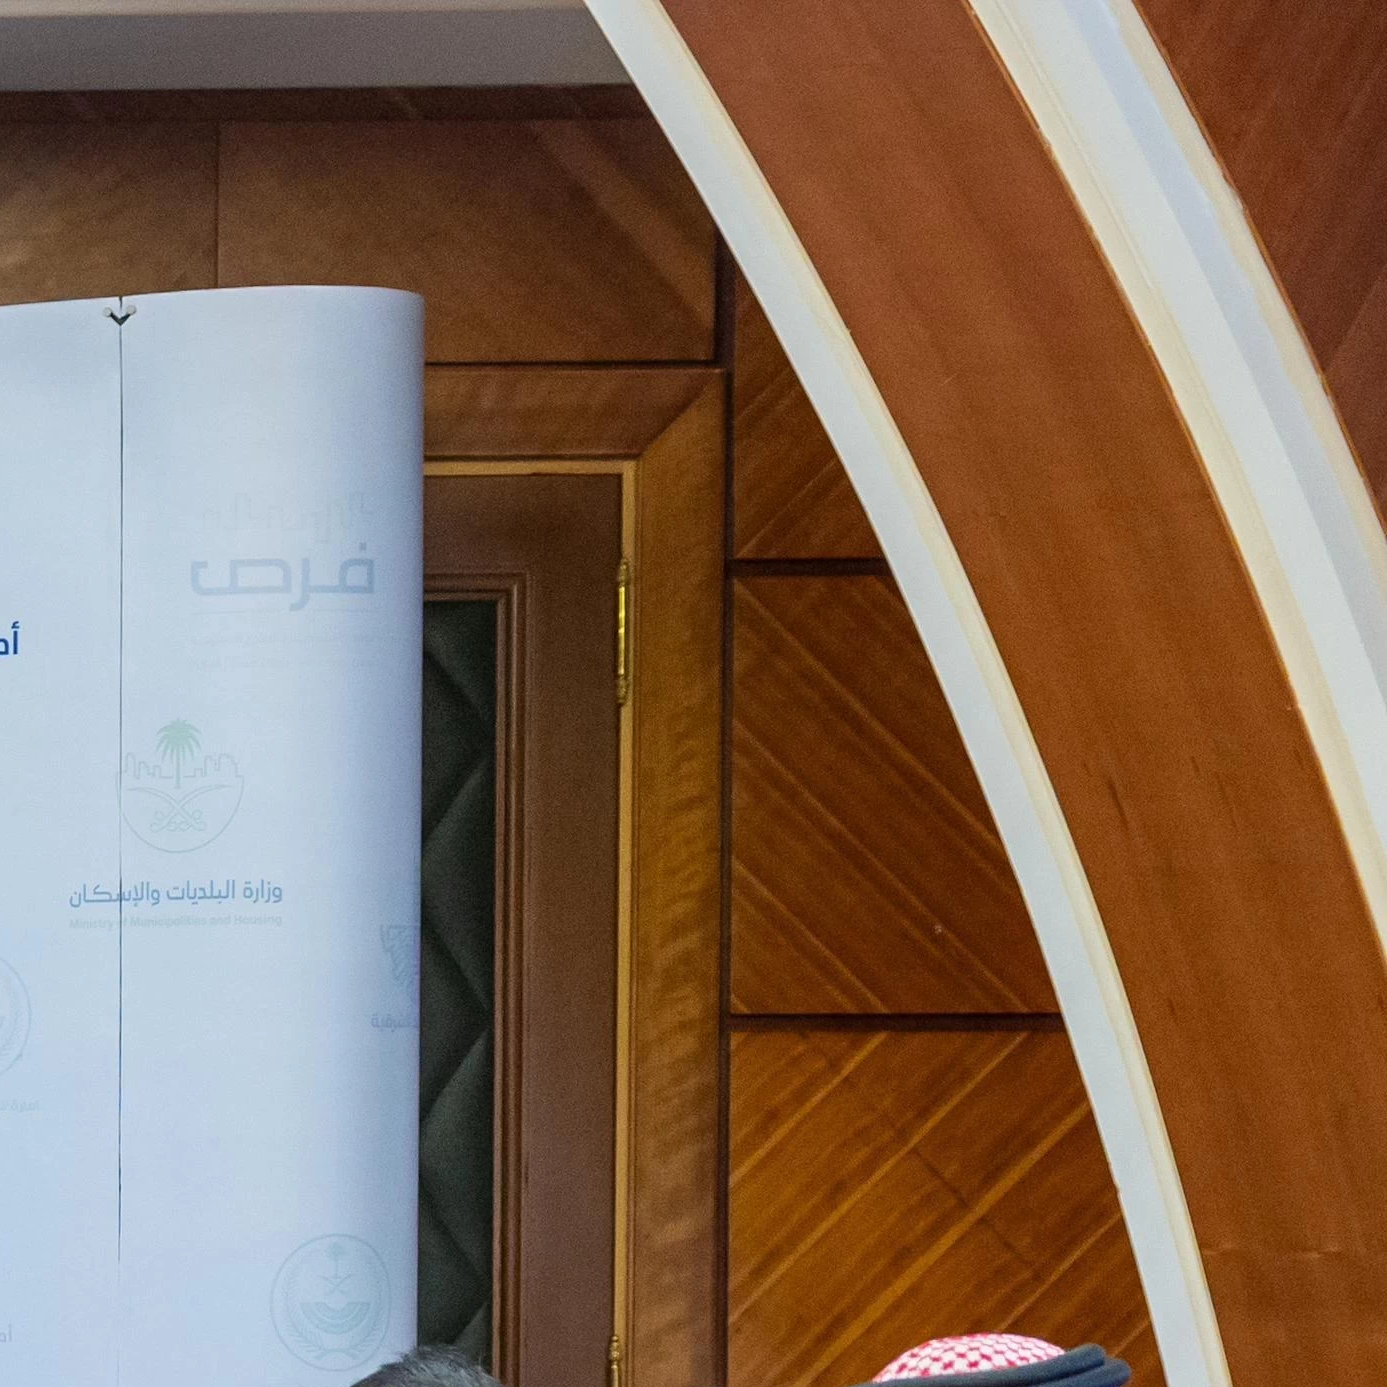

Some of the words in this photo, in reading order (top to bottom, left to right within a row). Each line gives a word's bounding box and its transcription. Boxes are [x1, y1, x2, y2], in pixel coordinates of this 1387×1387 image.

[190, 542, 374, 611] فرص
[166, 879, 235, 905] البلديات
[242, 879, 284, 904] وزارة
